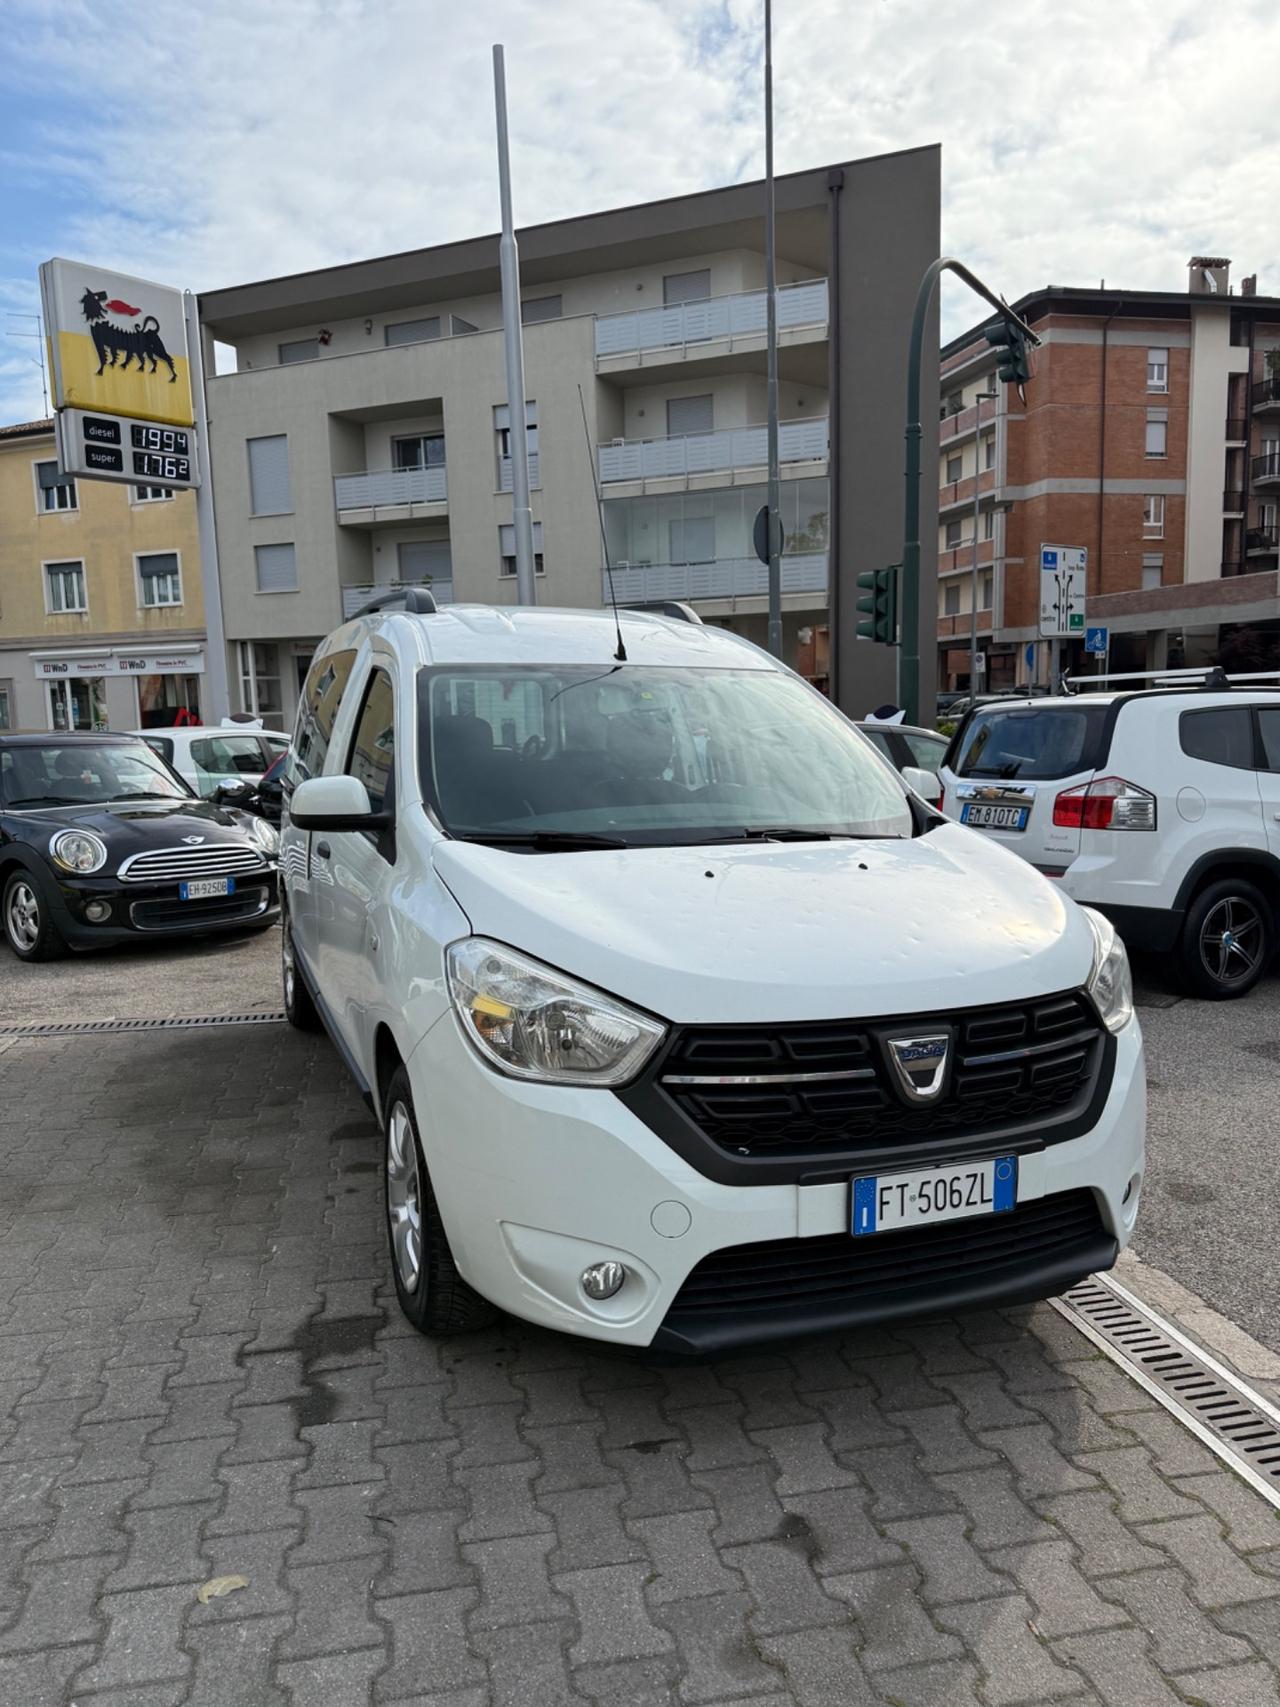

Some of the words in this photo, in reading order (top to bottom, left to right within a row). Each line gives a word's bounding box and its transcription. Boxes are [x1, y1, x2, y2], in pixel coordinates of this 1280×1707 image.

[89, 426, 115, 439] diesel
[91, 453, 116, 464] super
[968, 806, 982, 823] EM
[984, 807, 1020, 826] 810TC
[879, 1183, 909, 1221] FT
[918, 1172, 993, 1214] 506ZL
